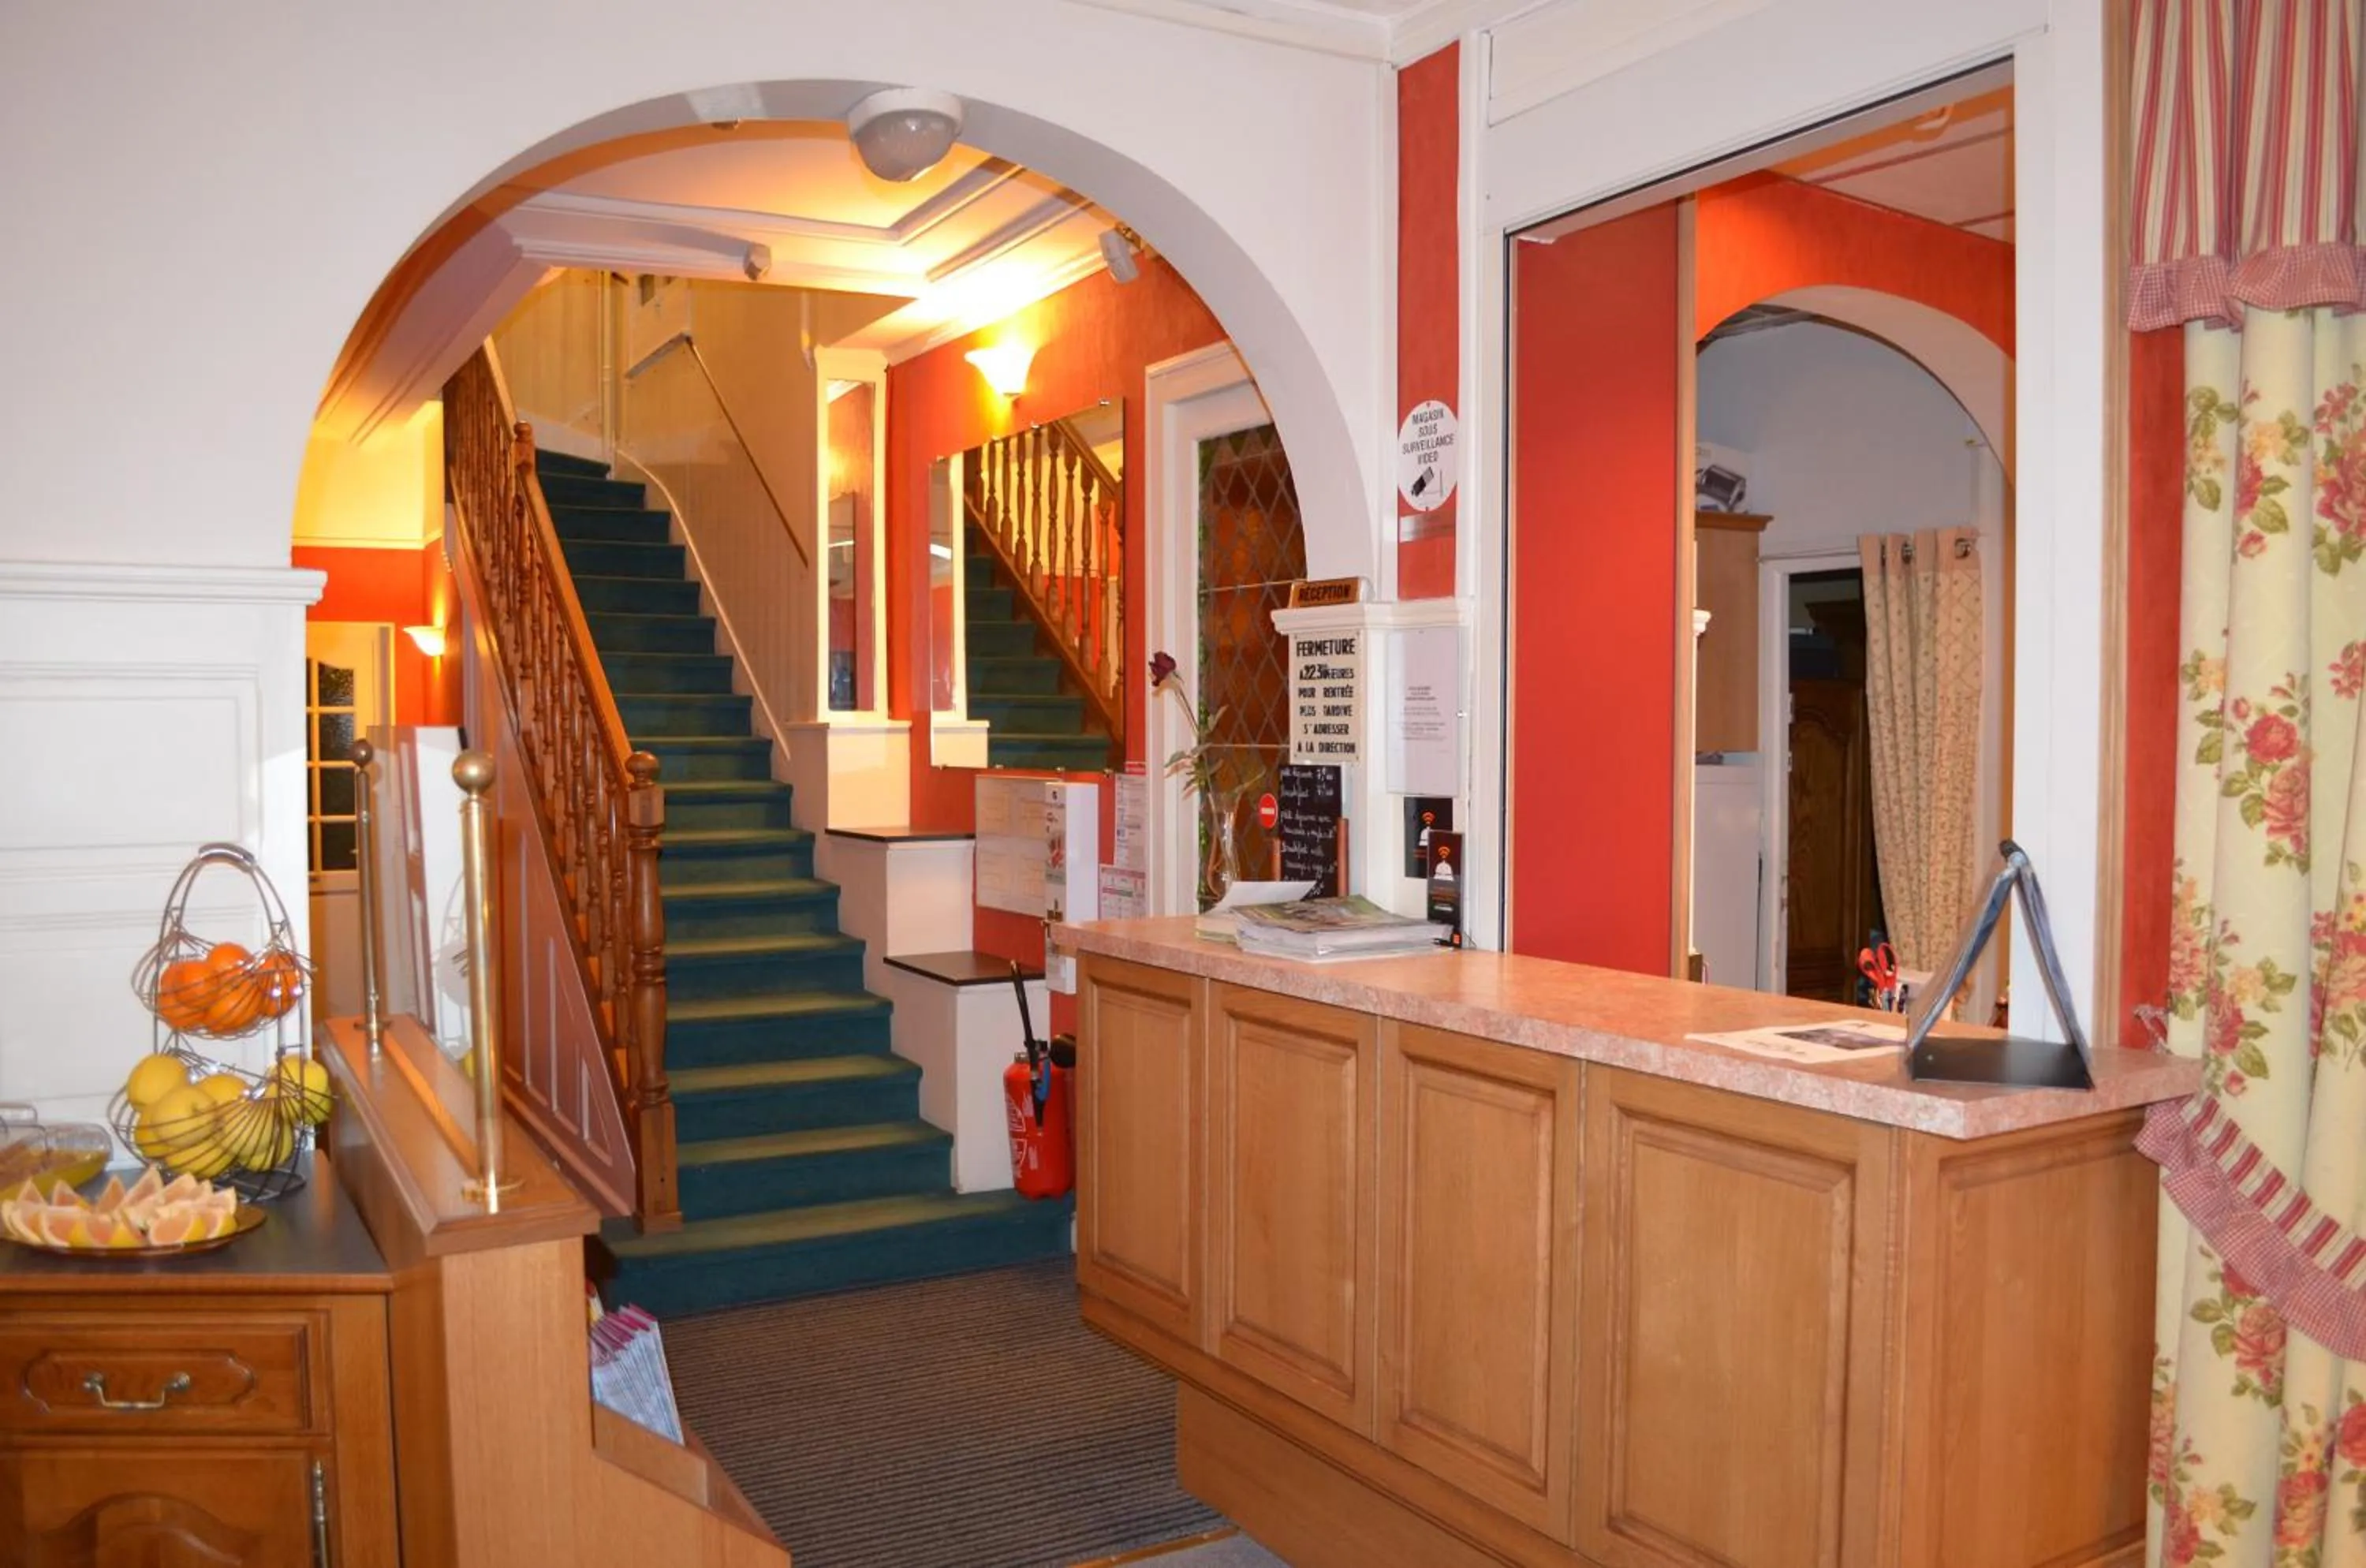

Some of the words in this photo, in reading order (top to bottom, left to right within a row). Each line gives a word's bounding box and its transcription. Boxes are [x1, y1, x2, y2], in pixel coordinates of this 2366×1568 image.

[1412, 408, 1444, 424] MAGASIN
[1419, 424, 1438, 437] SOUS
[1402, 433, 1454, 454] SURVEILLANCE
[1297, 638, 1356, 657] FERMETURE
[1298, 687, 1315, 698] POUR
[1323, 683, 1353, 698] RENTRÉE
[1299, 705, 1316, 716] PLUS
[1323, 704, 1353, 716] TARDIVE
[1306, 741, 1315, 752] LA
[1319, 742, 1355, 753] DIRECTION
